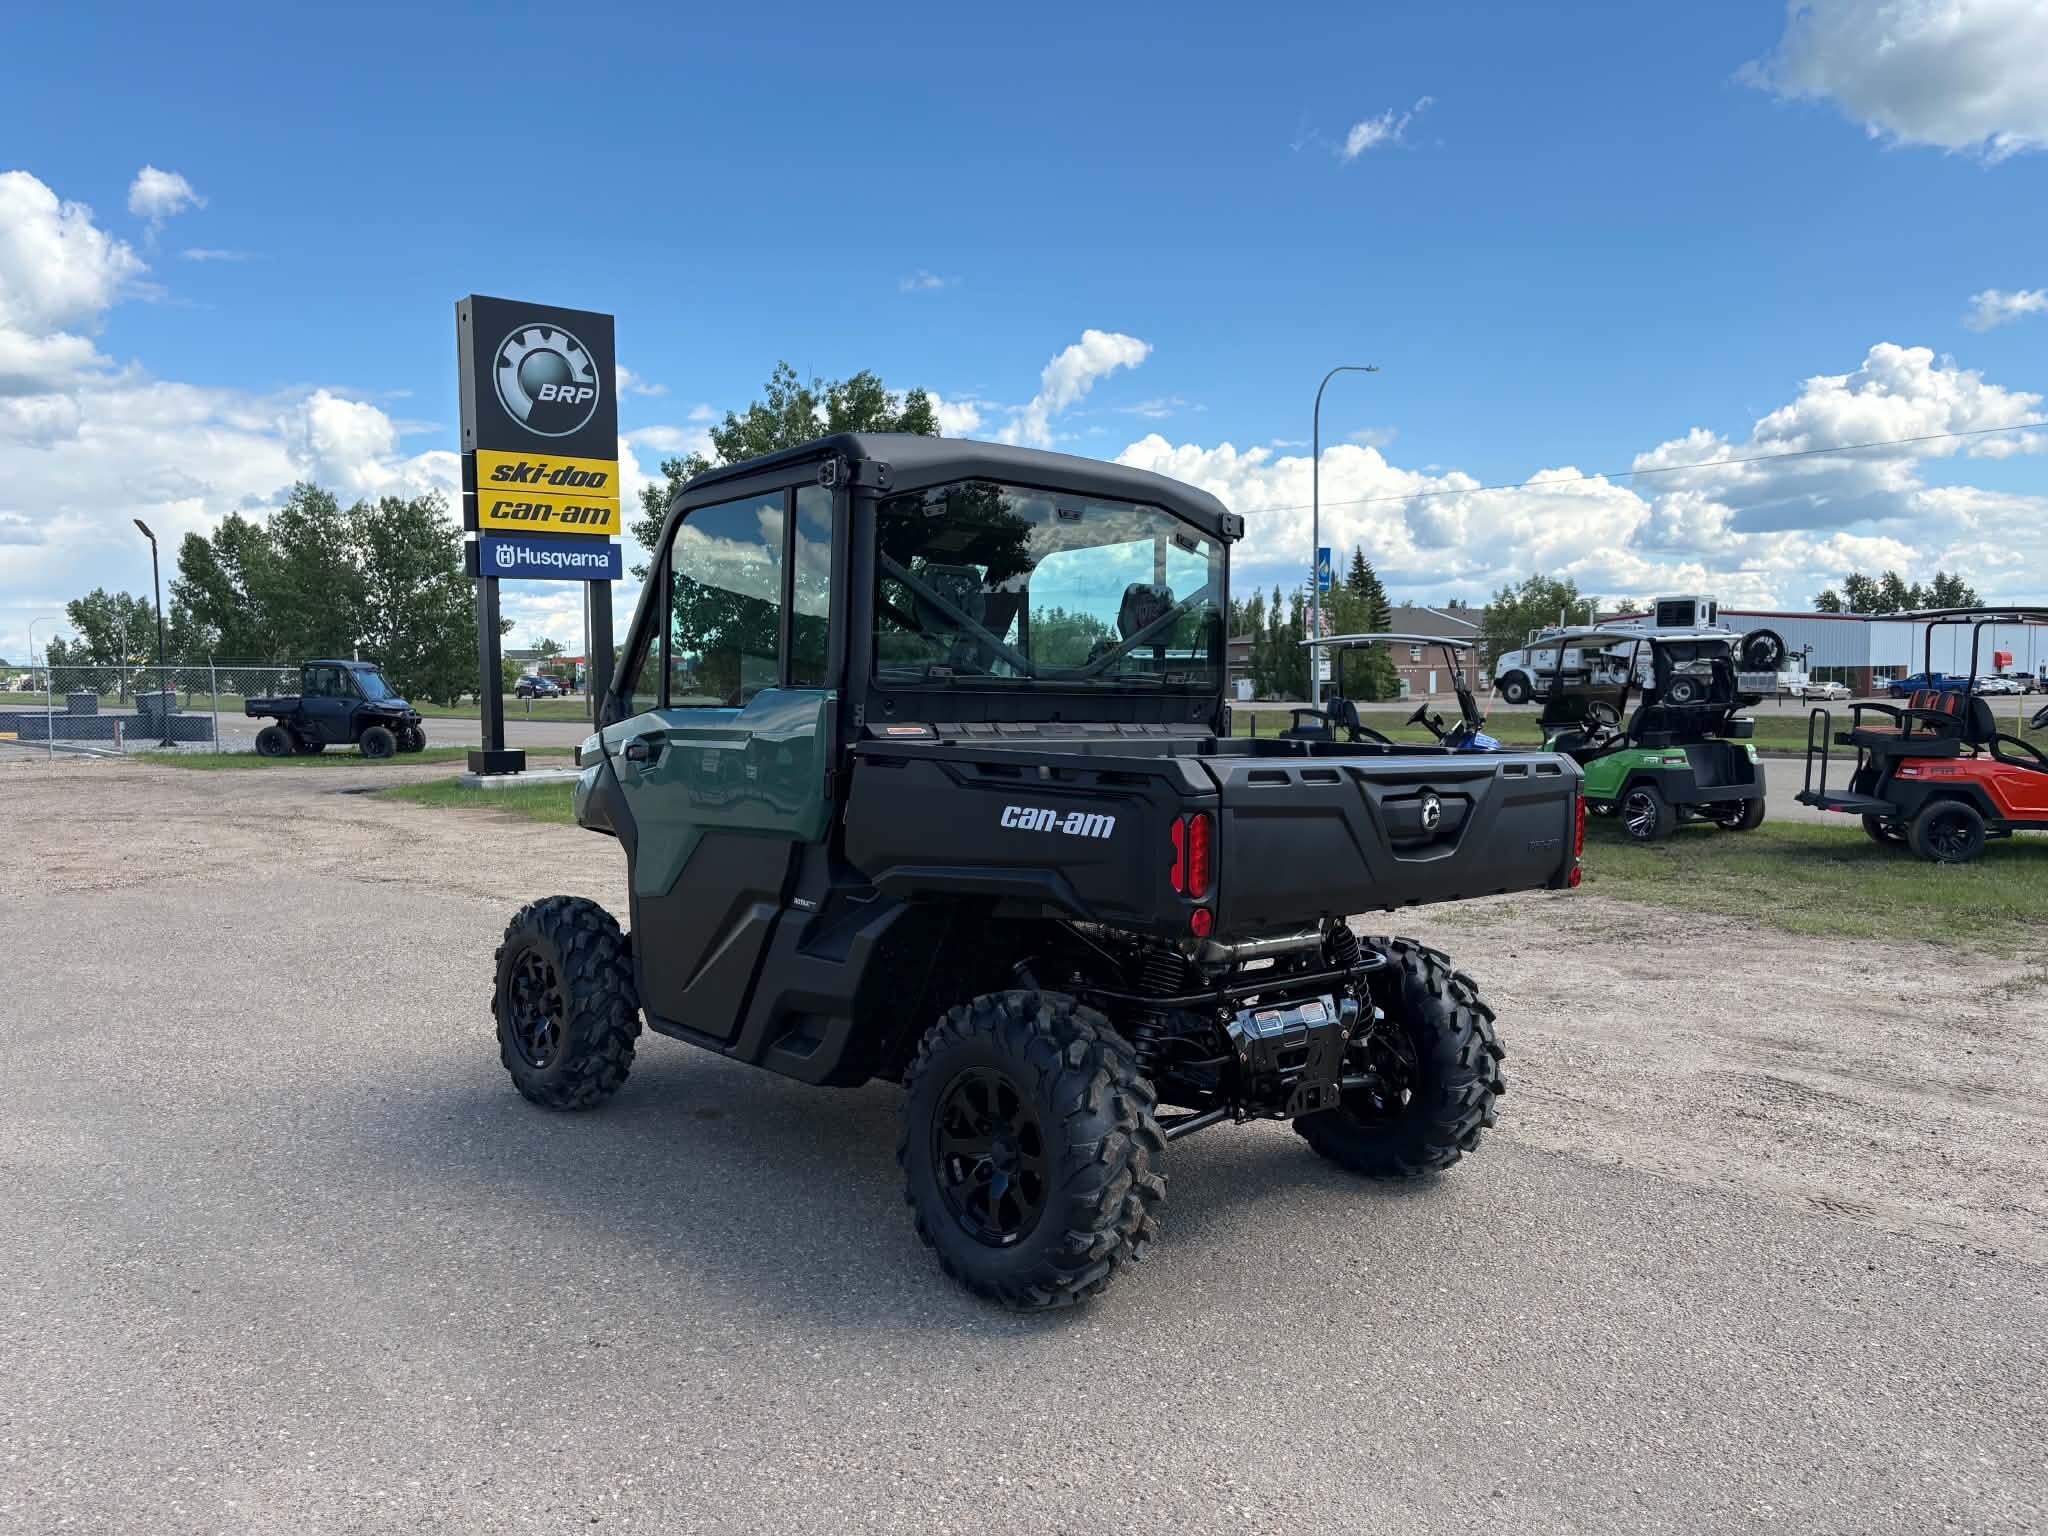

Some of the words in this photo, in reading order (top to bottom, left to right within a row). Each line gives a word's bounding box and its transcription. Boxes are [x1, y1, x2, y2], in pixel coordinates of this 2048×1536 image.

[538, 384, 594, 404] BRP
[490, 462, 608, 489] ski-doo
[490, 501, 611, 526] can-am
[516, 547, 609, 568] Husqvarna
[1000, 806, 1116, 839] can-am
